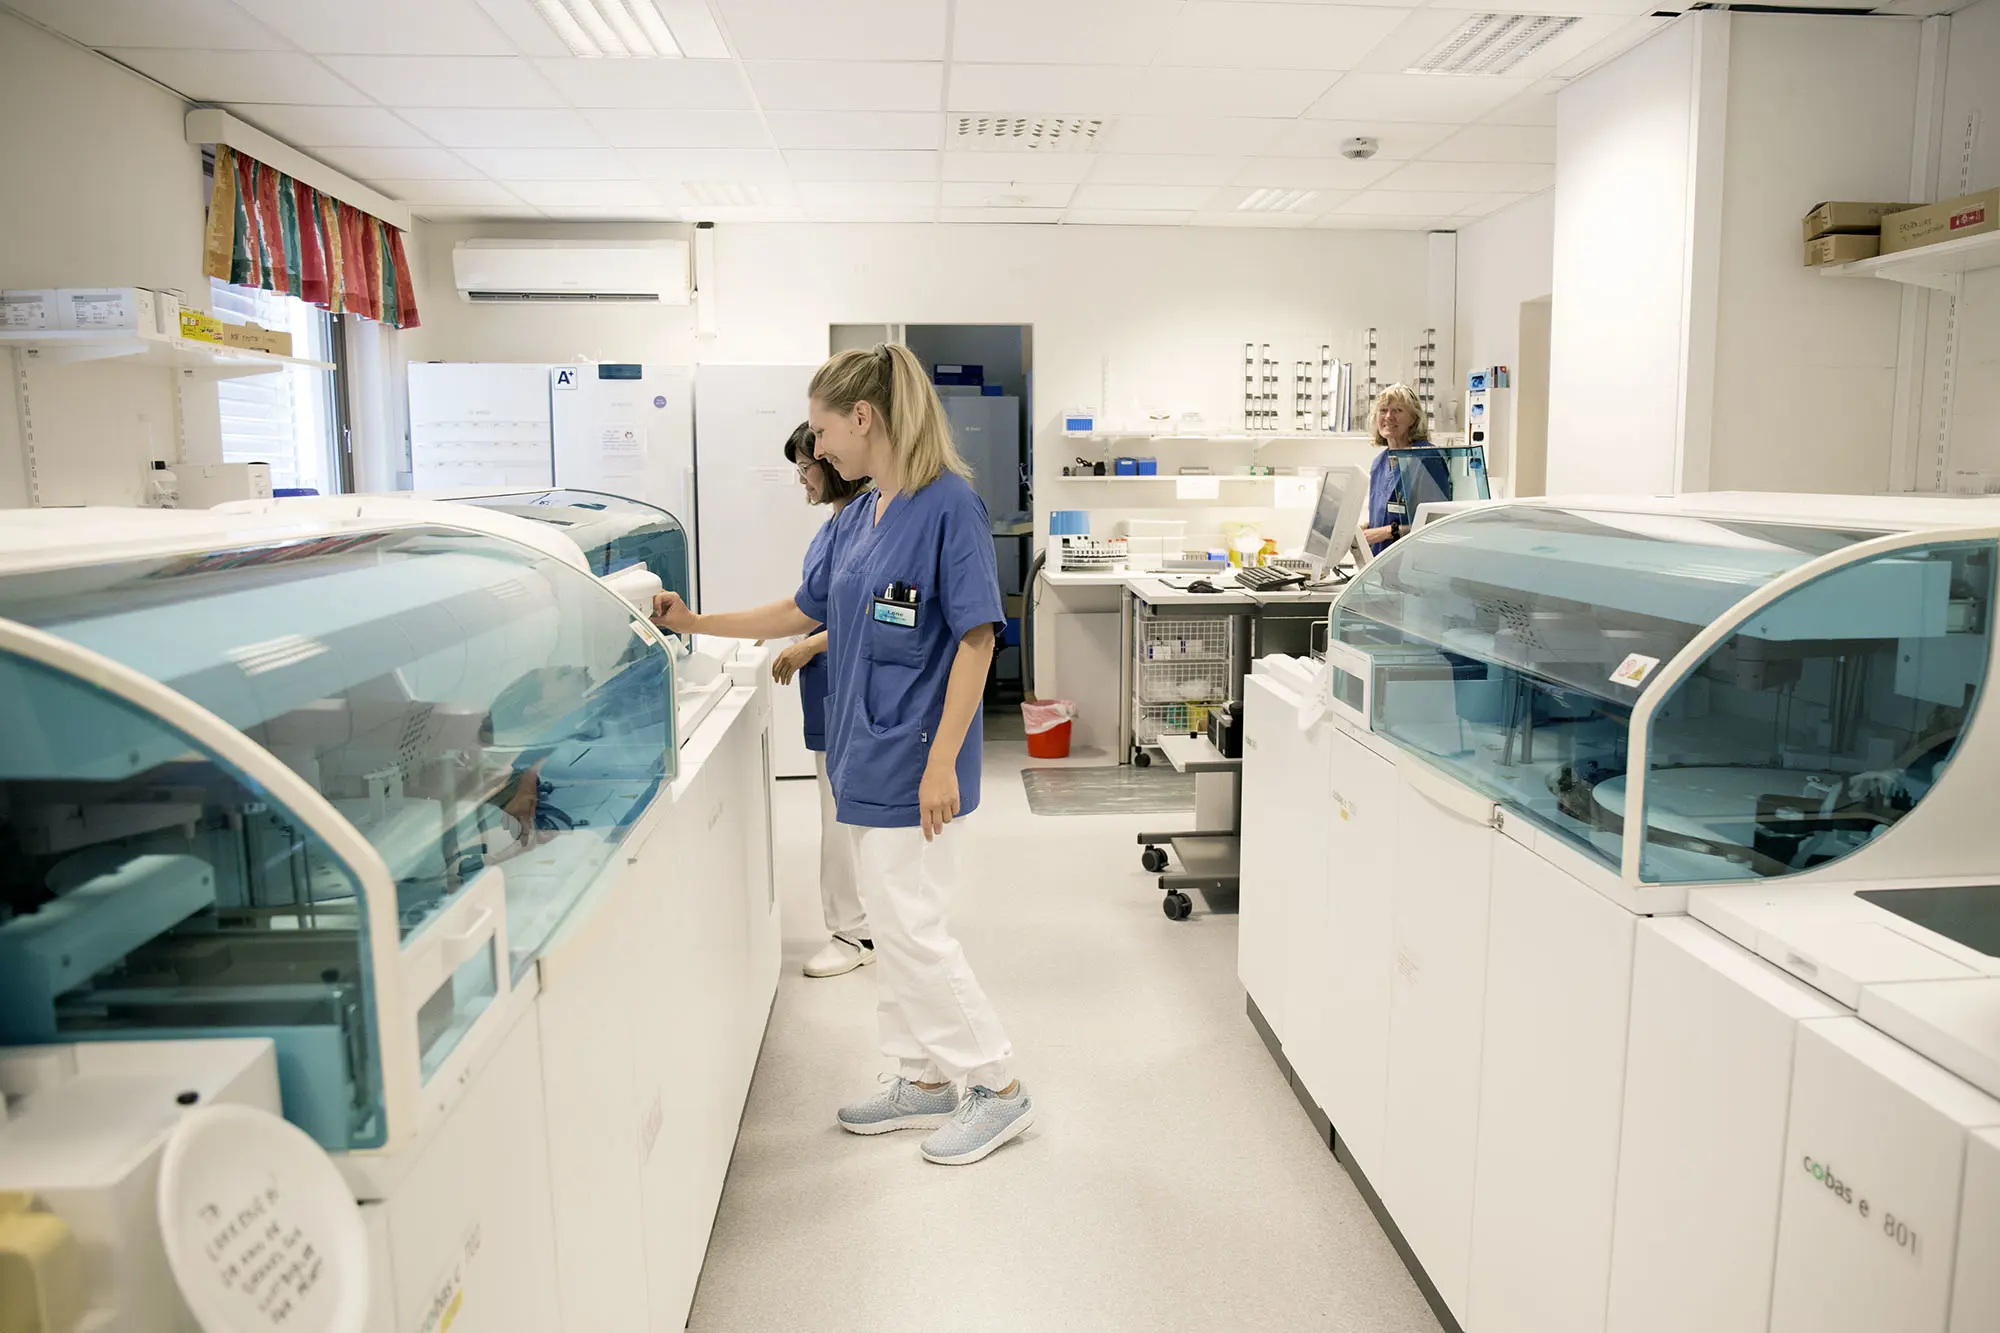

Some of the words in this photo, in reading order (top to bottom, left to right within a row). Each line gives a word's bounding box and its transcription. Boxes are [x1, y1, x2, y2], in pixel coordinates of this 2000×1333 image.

[558, 370, 574, 385] A+
[1803, 1156, 1853, 1205] cobas
[1858, 1198, 1870, 1218] e
[1883, 1212, 1918, 1256] 801
